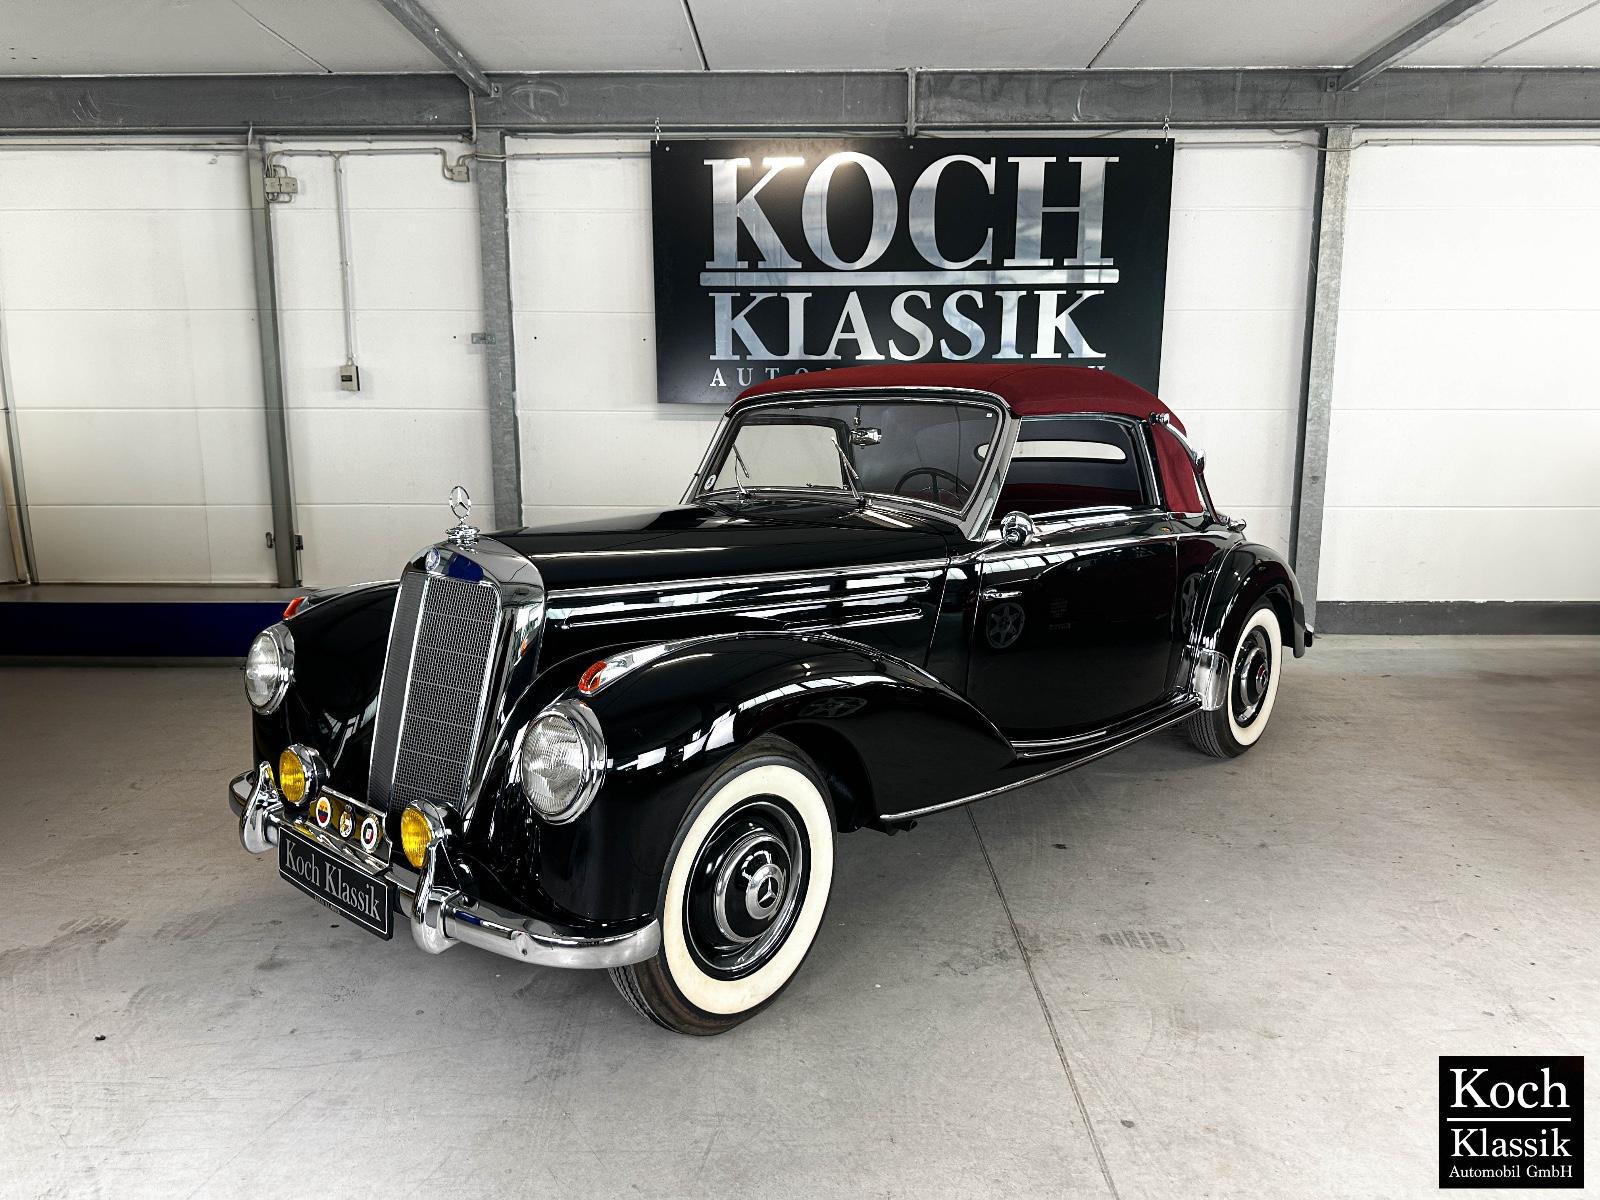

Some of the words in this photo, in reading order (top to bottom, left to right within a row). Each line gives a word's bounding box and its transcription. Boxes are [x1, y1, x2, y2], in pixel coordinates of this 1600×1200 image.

[703, 151, 1120, 270] KOCH
[708, 289, 1107, 361] KLASSIK
[286, 839, 320, 886] Koch
[324, 862, 381, 921] Klassik
